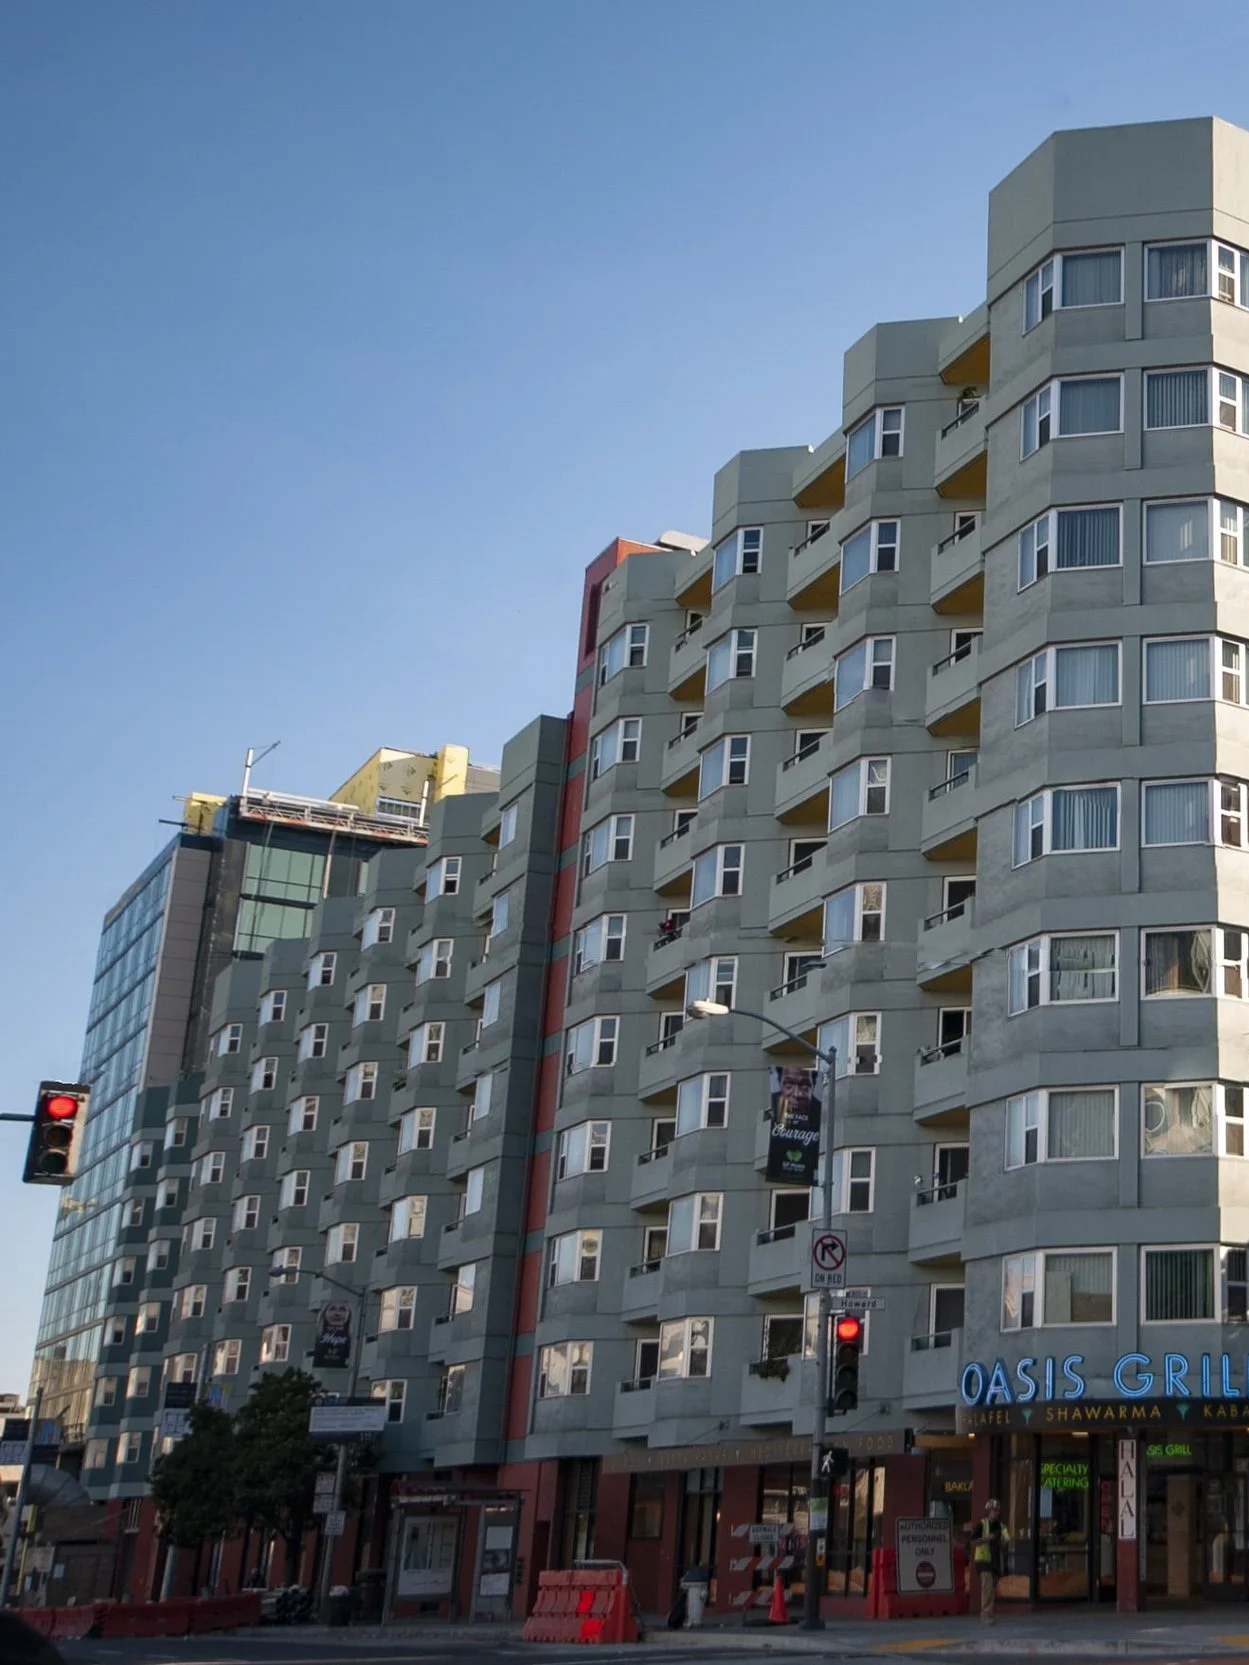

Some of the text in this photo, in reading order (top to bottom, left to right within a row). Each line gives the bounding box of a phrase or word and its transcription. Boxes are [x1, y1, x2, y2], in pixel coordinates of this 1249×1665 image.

[772, 1122, 820, 1146] Courage
[815, 1273, 842, 1284] ON RED
[841, 1299, 877, 1308] Howard
[960, 1356, 1086, 1405] OASIS
[1045, 1403, 1162, 1421] SHAWARMA
[857, 1434, 895, 1451] FOOD
[1165, 1443, 1193, 1457] GRILL
[1120, 1441, 1134, 1537] HALAL
[900, 1521, 949, 1530] AUTHORIZED
[902, 1534, 947, 1544] PERSONNEL
[915, 1547, 935, 1556] ONLY
